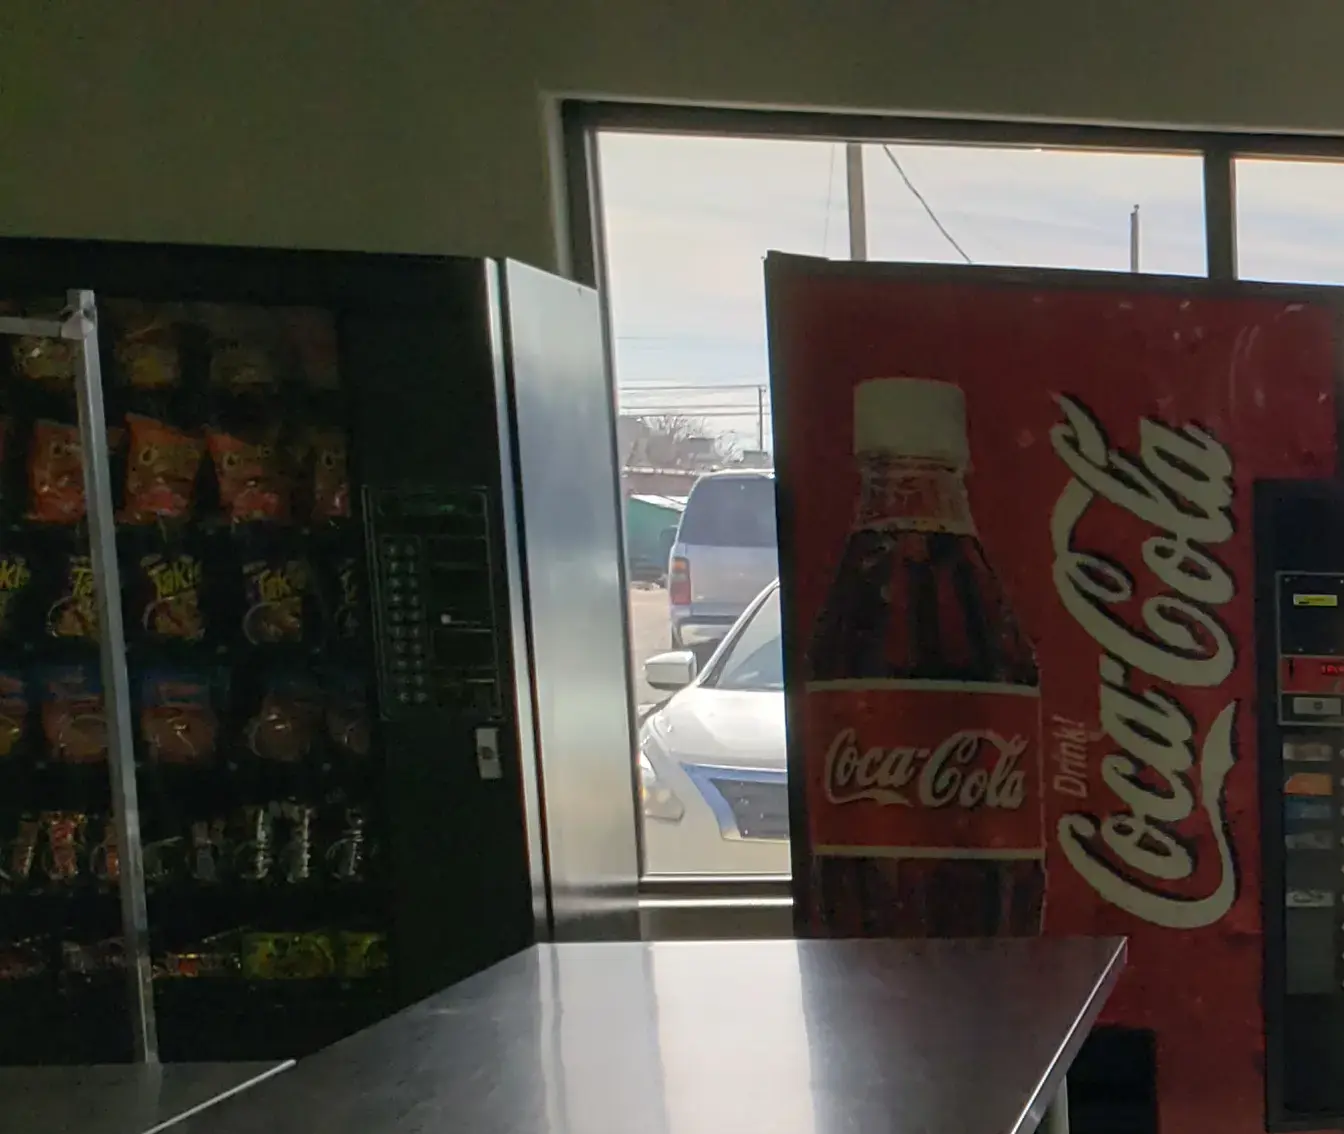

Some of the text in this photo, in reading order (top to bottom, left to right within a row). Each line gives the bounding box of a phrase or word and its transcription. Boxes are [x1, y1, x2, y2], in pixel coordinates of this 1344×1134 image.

[1047, 390, 1237, 929] Coca-Cola
[824, 727, 1029, 810] Coca-Cola
[1053, 714, 1090, 799] Drink!
